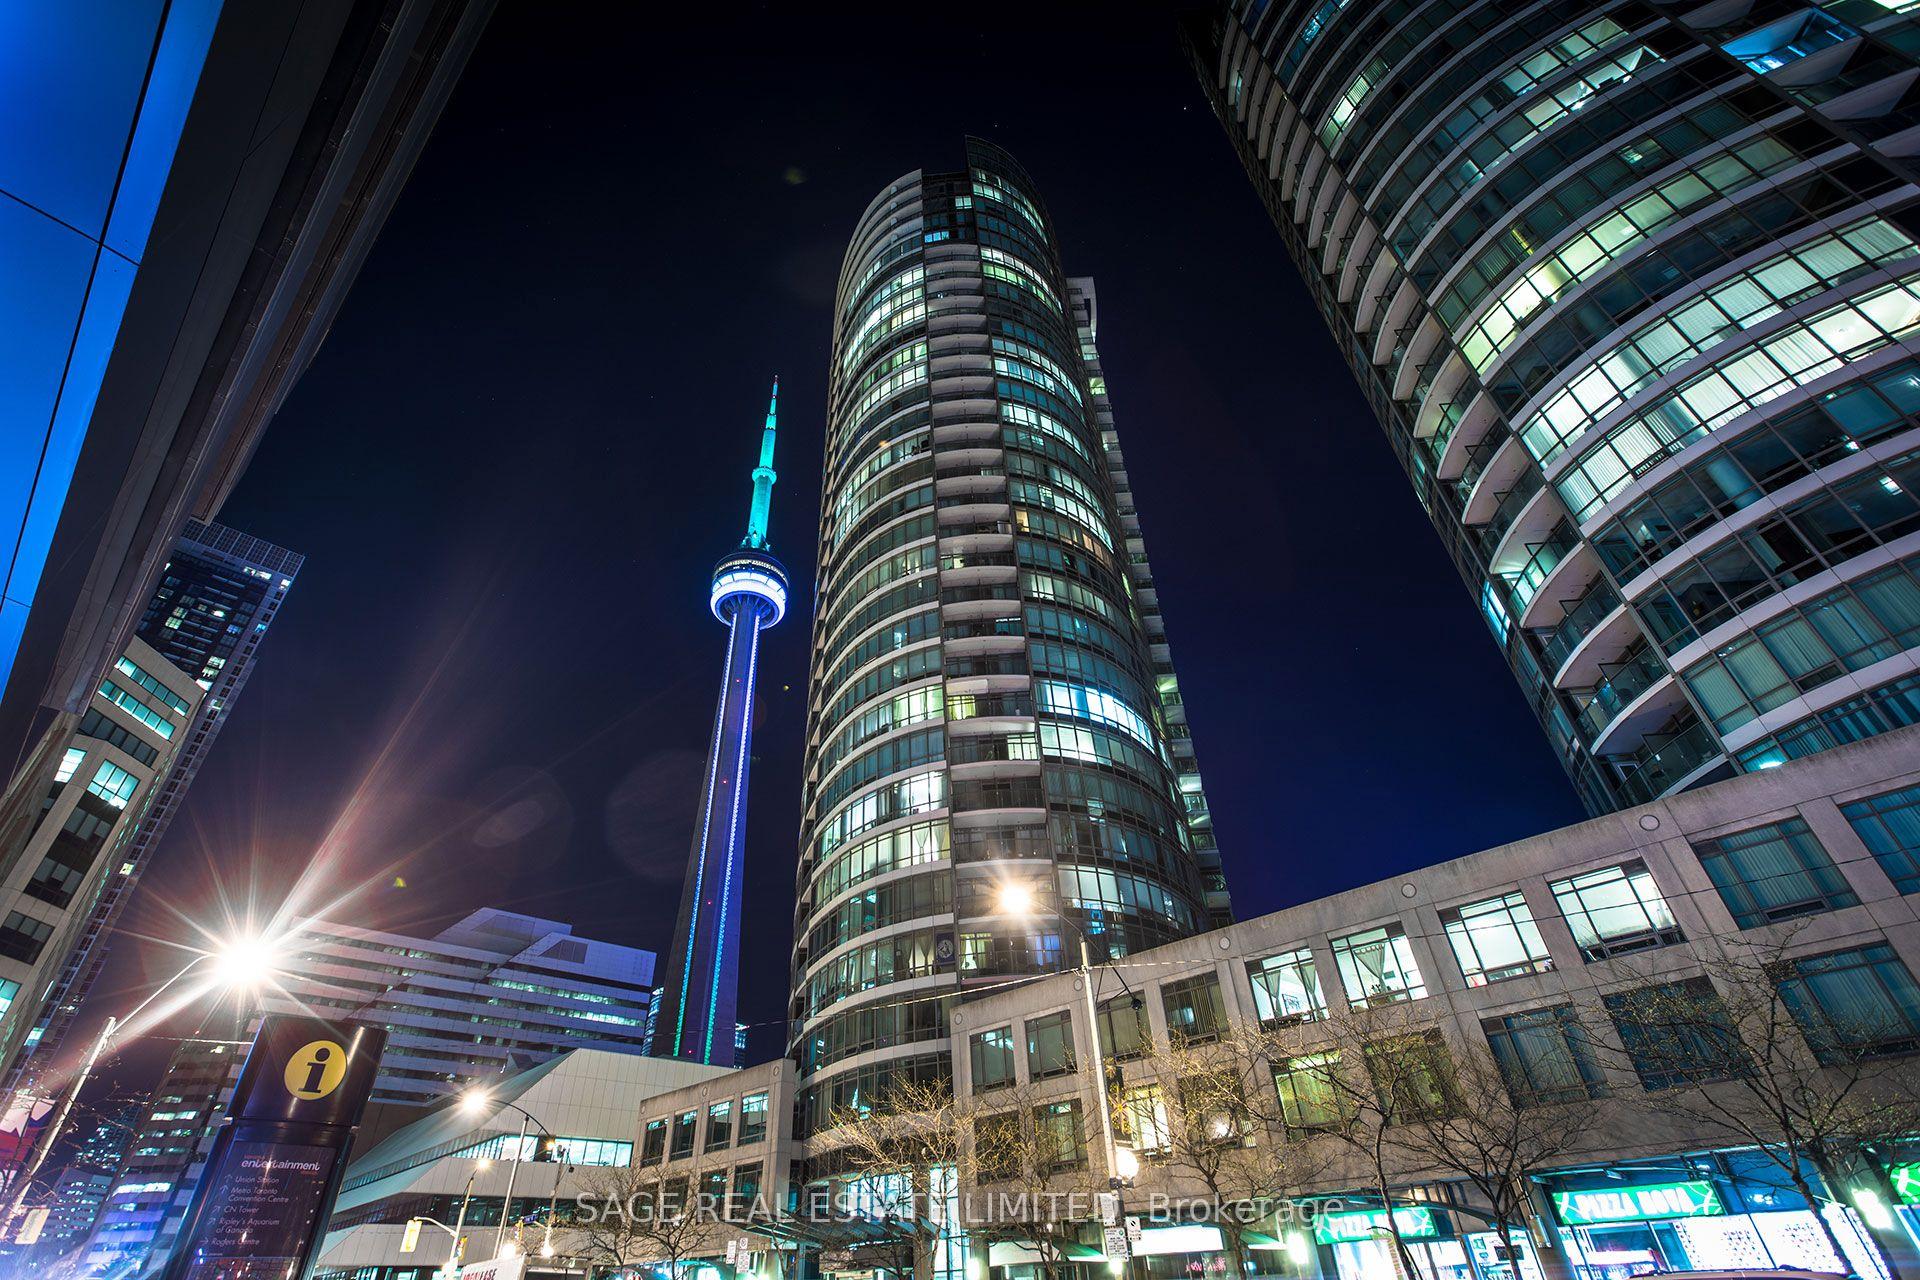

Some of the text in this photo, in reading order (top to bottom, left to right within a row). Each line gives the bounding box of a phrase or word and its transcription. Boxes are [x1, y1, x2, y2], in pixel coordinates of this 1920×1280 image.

[241, 1159, 321, 1171] entertainment
[253, 1187, 278, 1195] Toronto
[267, 1195, 290, 1203] Centre
[1574, 1186, 1696, 1220] PIZZA NOVA
[219, 1218, 280, 1226] Ripley's Aquarium
[216, 1226, 224, 1234] of
[211, 1239, 236, 1248] Rogers
